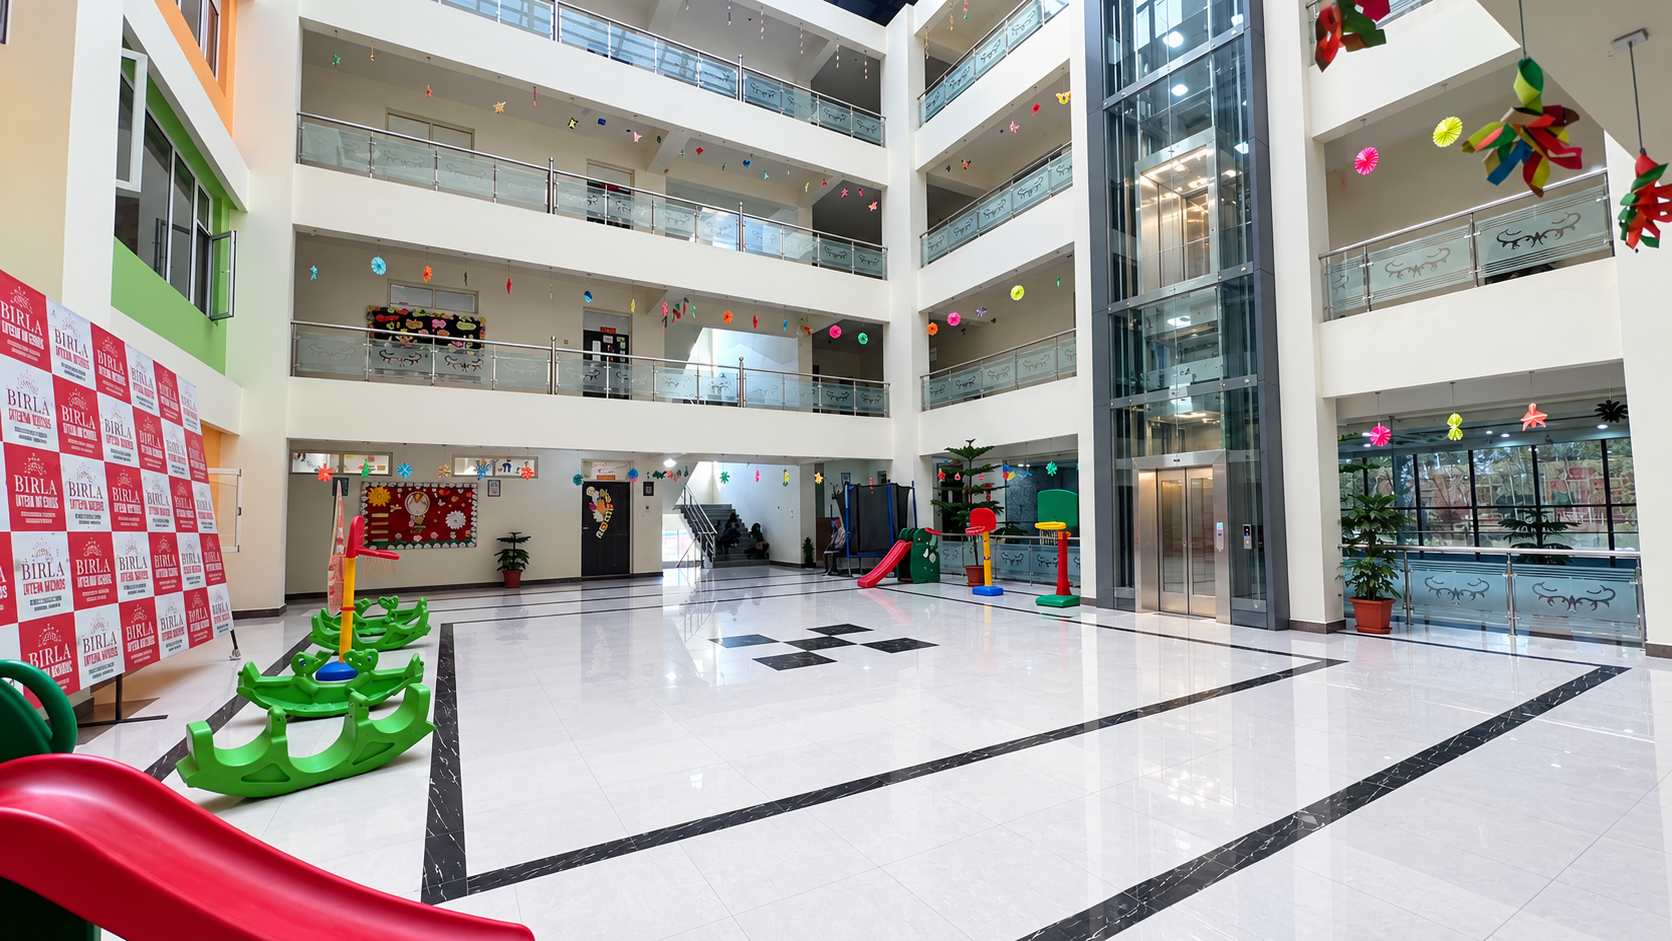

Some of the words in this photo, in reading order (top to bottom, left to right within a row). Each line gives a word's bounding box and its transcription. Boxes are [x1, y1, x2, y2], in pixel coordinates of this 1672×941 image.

[0, 301, 43, 336] BIRLA
[55, 328, 89, 358] BIRLA
[97, 349, 124, 375] BIRLA
[7, 388, 50, 416] BIRLA
[60, 404, 96, 430] BIRLA
[105, 419, 132, 439] BIRLA
[14, 474, 58, 495] BIRLA
[68, 481, 103, 499] BIRLA
[112, 487, 141, 504] BIRLA
[21, 562, 65, 580] BIRLA
[76, 558, 111, 575] BIRLA
[119, 556, 147, 571] BIRLA
[154, 554, 177, 568] BIRLA
[126, 621, 154, 641] BIRLA
[161, 614, 184, 632] BIRLA
[83, 631, 117, 653] BIRLA
[28, 643, 72, 668] BIRLA
